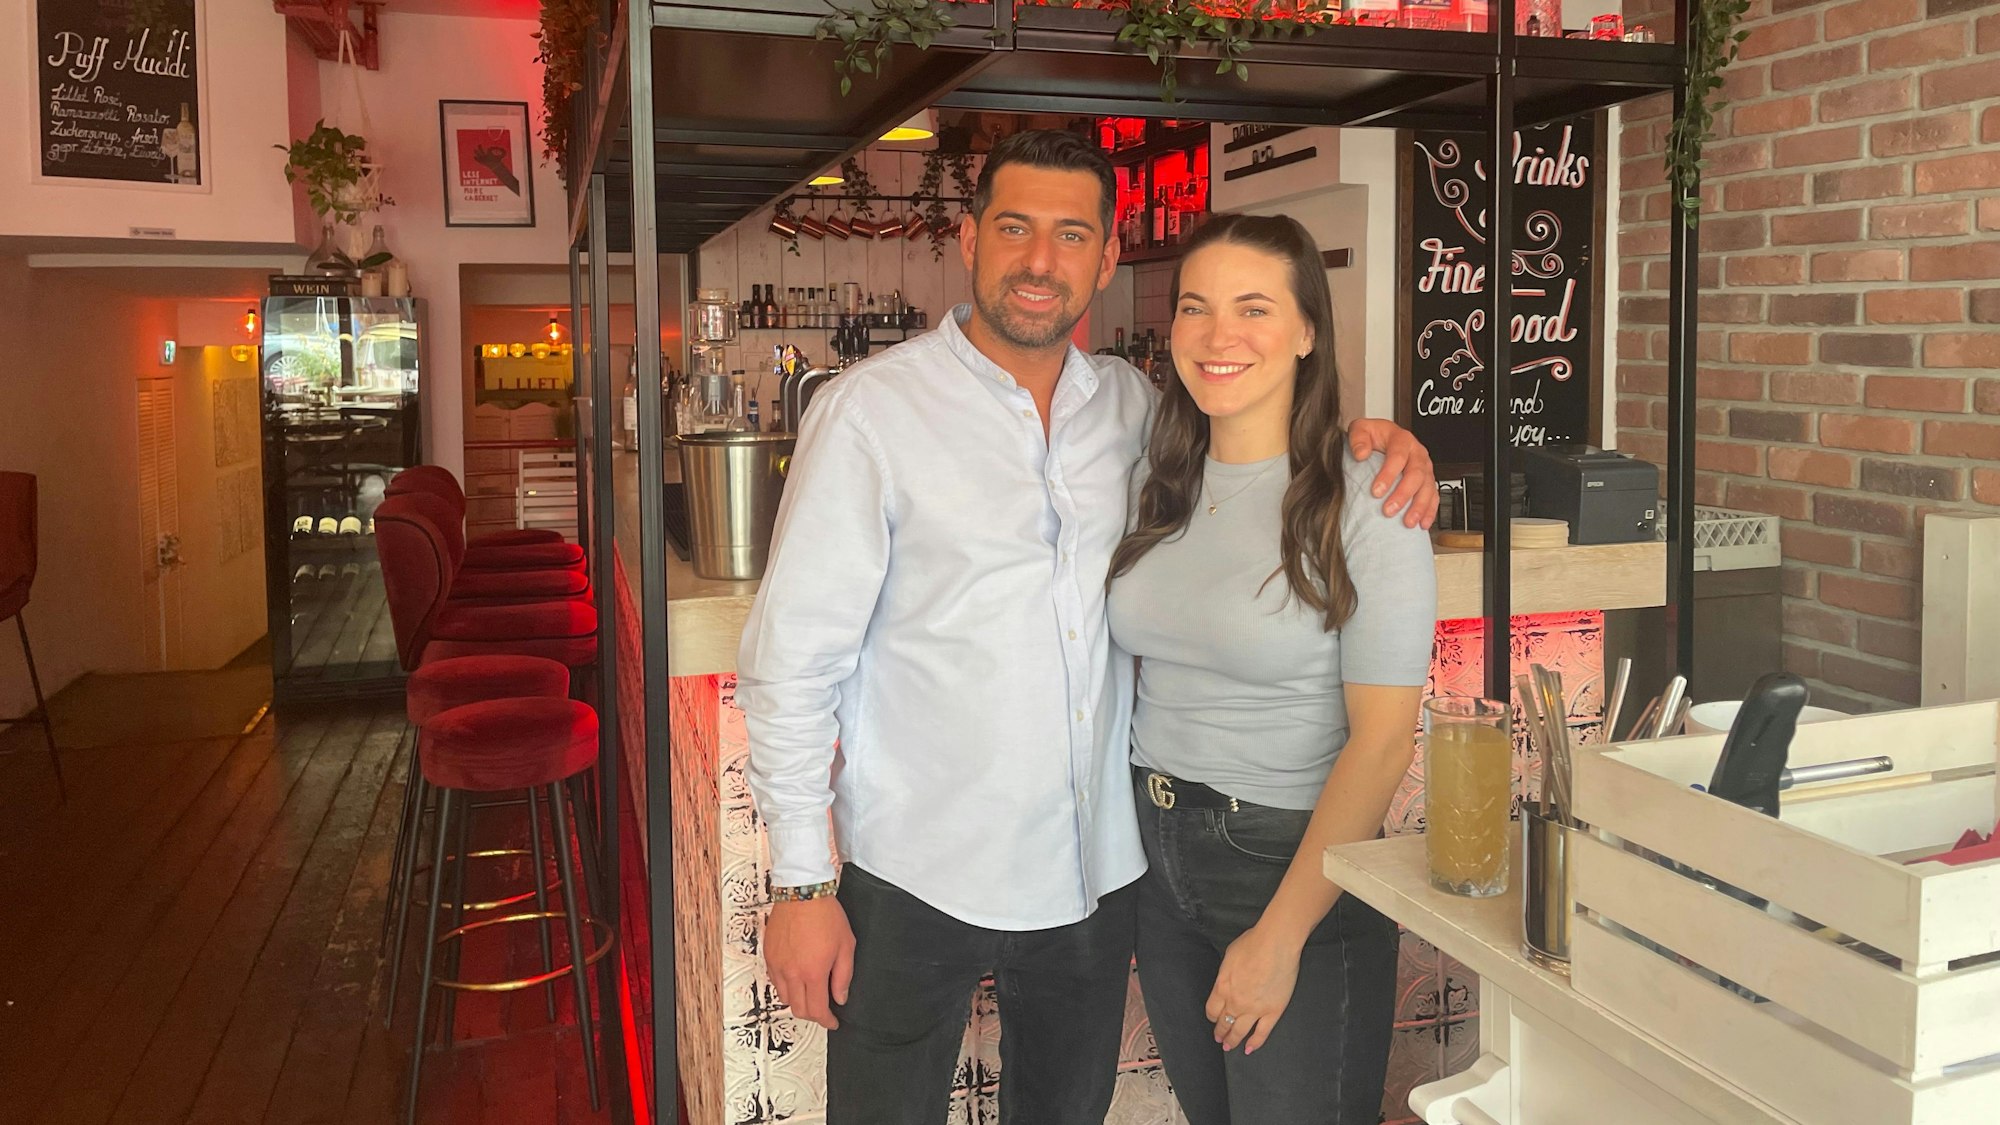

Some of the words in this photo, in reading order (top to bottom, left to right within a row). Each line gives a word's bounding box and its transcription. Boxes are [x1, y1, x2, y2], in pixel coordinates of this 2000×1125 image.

[48, 31, 109, 83] Puff
[51, 83, 89, 103] Lillet
[1475, 124, 1590, 189] rinks
[293, 284, 331, 294] WEIN
[1419, 238, 1486, 294] Fine
[1510, 278, 1578, 343] ood
[1417, 379, 1464, 416] Come
[1509, 379, 1544, 414] nd
